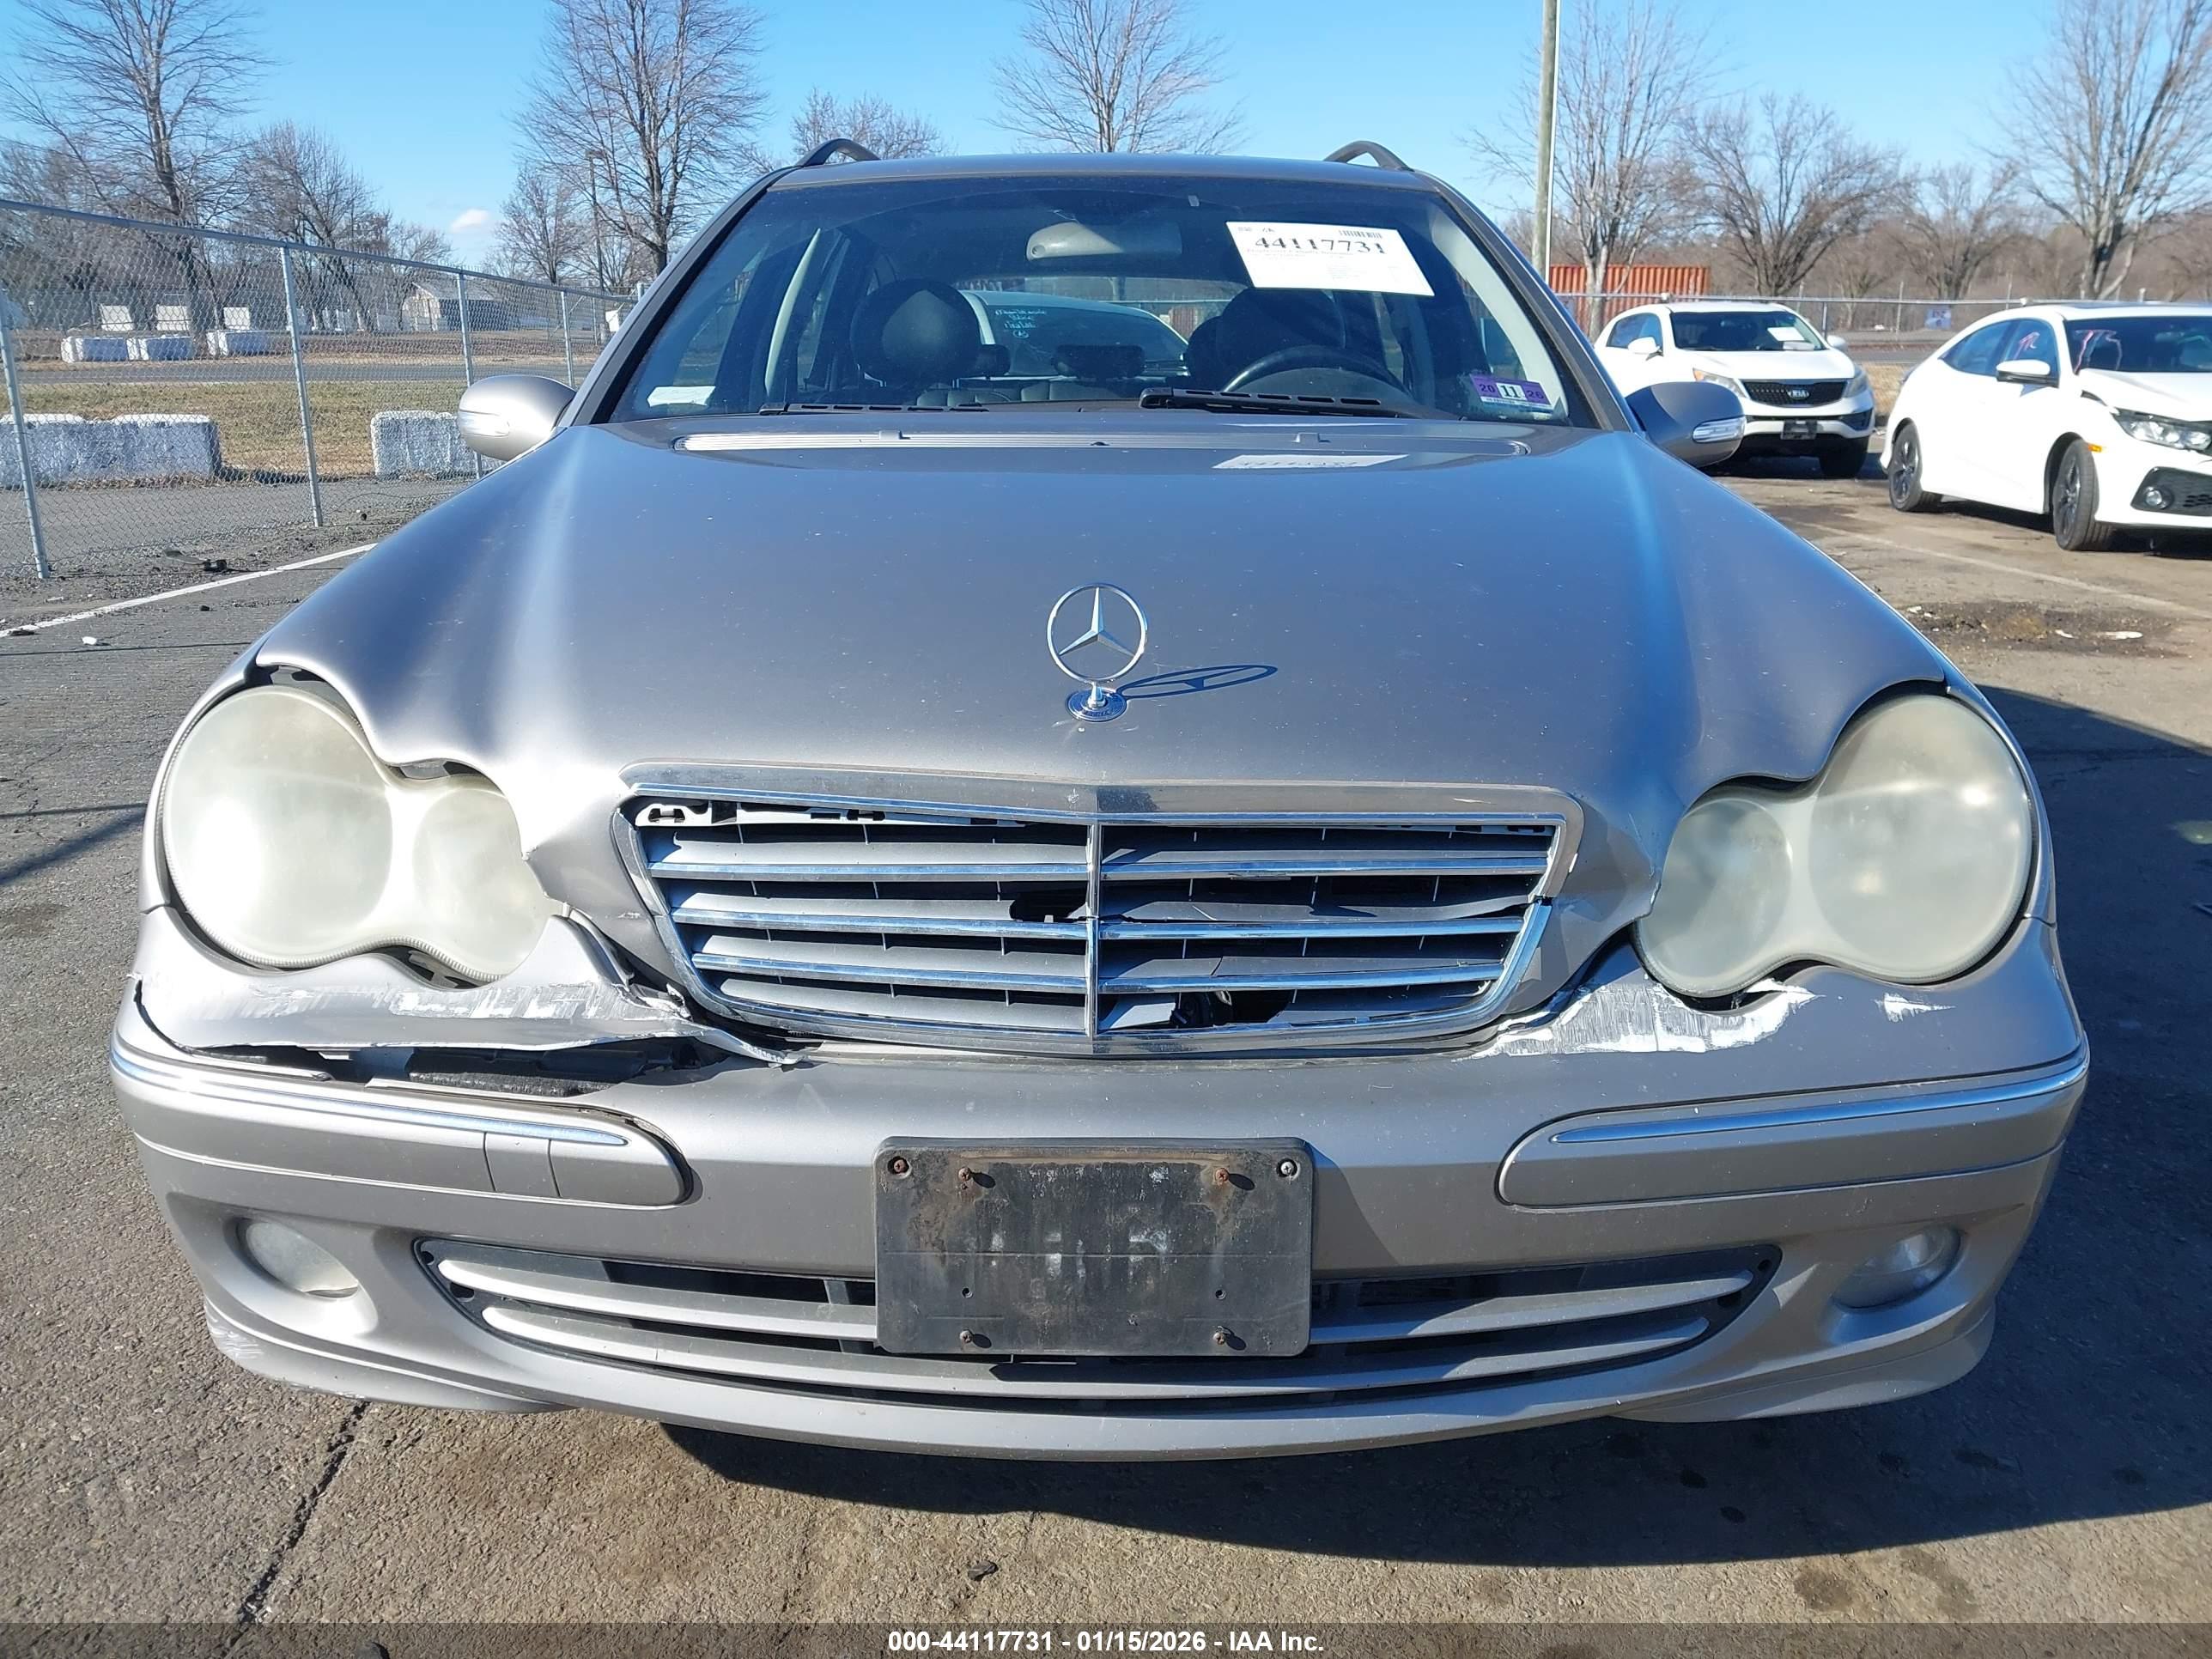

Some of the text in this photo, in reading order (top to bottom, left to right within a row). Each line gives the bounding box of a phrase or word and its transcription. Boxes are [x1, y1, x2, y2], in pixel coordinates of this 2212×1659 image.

[1255, 237, 1386, 253] 44117731
[1479, 383, 1496, 393] 20
[1500, 384, 1522, 398] 11
